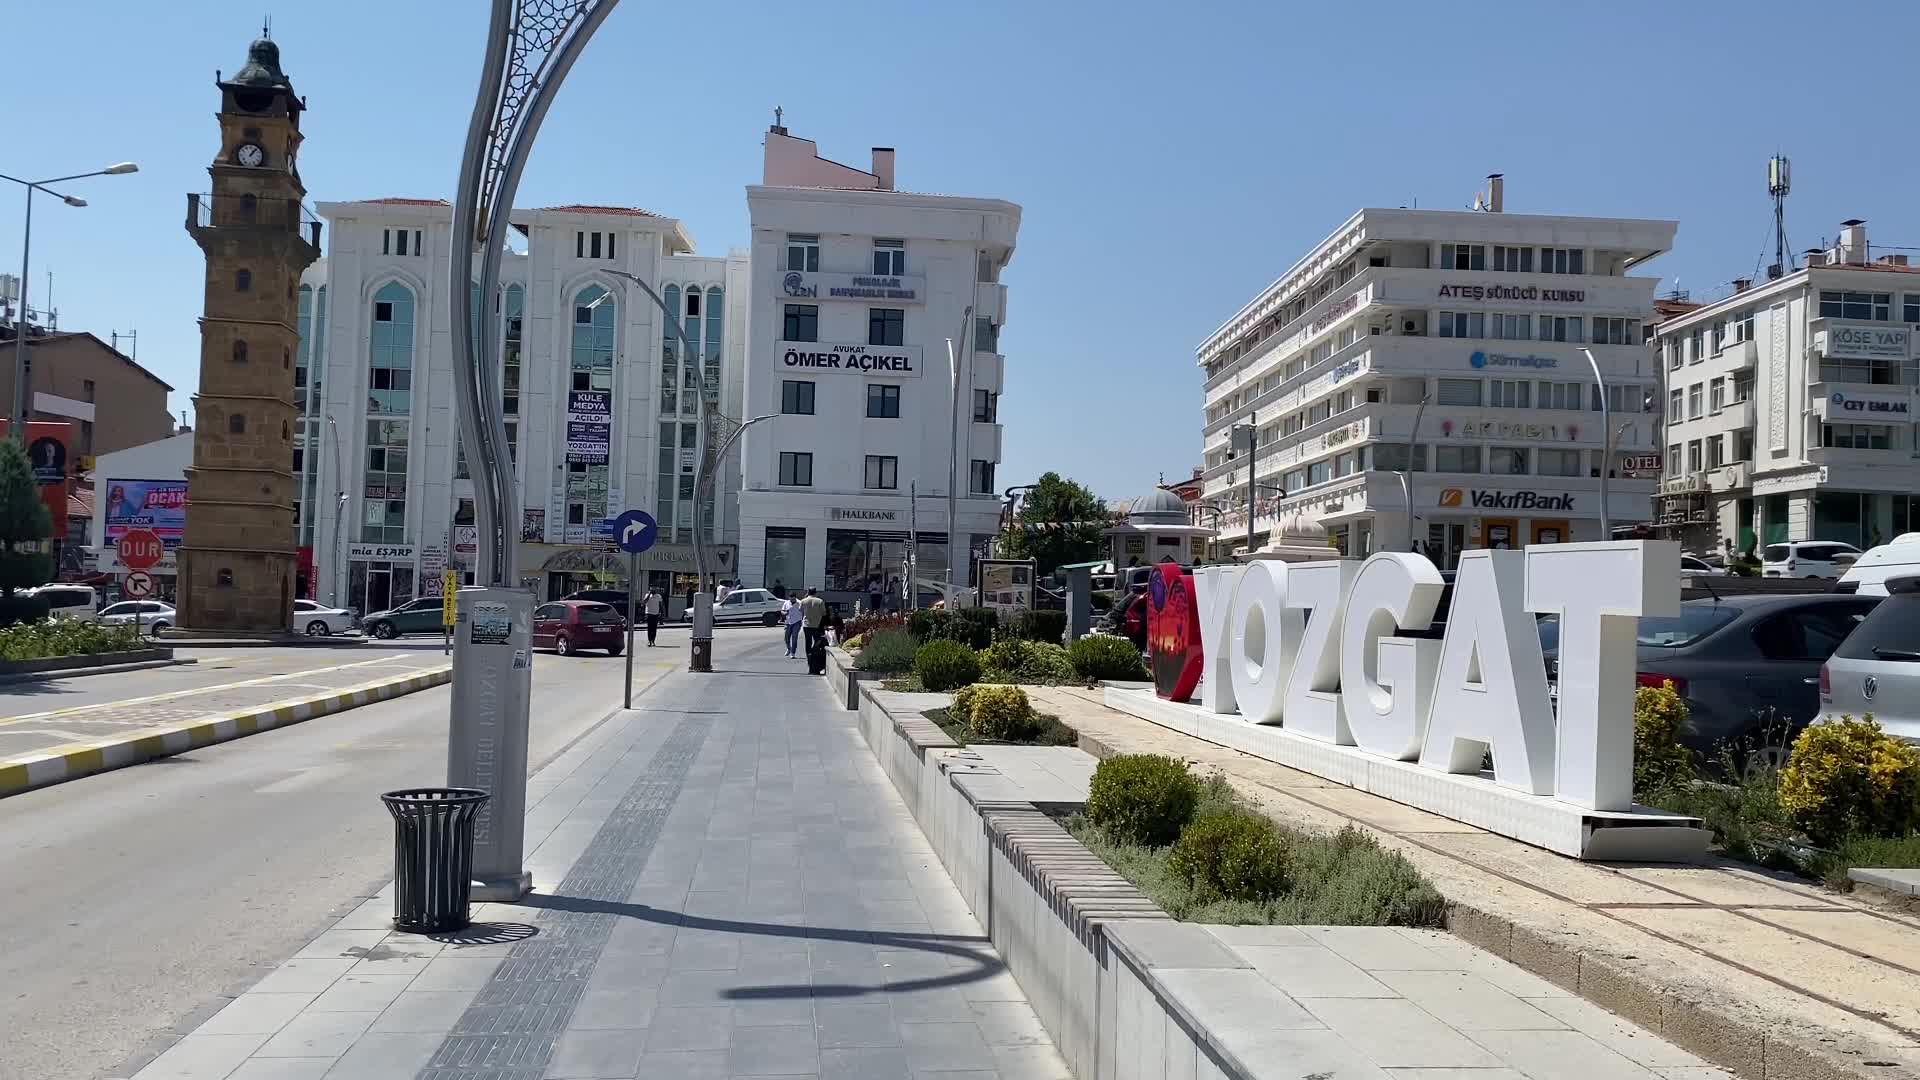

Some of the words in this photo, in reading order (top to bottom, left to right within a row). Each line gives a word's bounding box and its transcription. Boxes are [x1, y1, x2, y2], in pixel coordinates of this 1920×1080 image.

[1439, 284, 1484, 300] ATEŞ
[1486, 285, 1538, 300] SÜRÜCÜ
[1542, 288, 1585, 302] KURSU
[1832, 328, 1871, 344] KÖSE
[1875, 332, 1907, 345] YAPI
[833, 345, 866, 353] AVUKAT
[784, 348, 841, 369] ÖMER
[845, 354, 913, 373] AÇIKEL
[577, 393, 604, 402] KULE
[573, 401, 606, 410] MEDYA
[1623, 456, 1661, 470] OTEL
[1471, 489, 1576, 511] VakıfBank
[842, 510, 896, 520] HALKBANK
[121, 541, 159, 558] DUR
[352, 547, 372, 556] mia
[375, 548, 413, 559] EŞARP
[1193, 540, 1681, 812] YOZGAT
